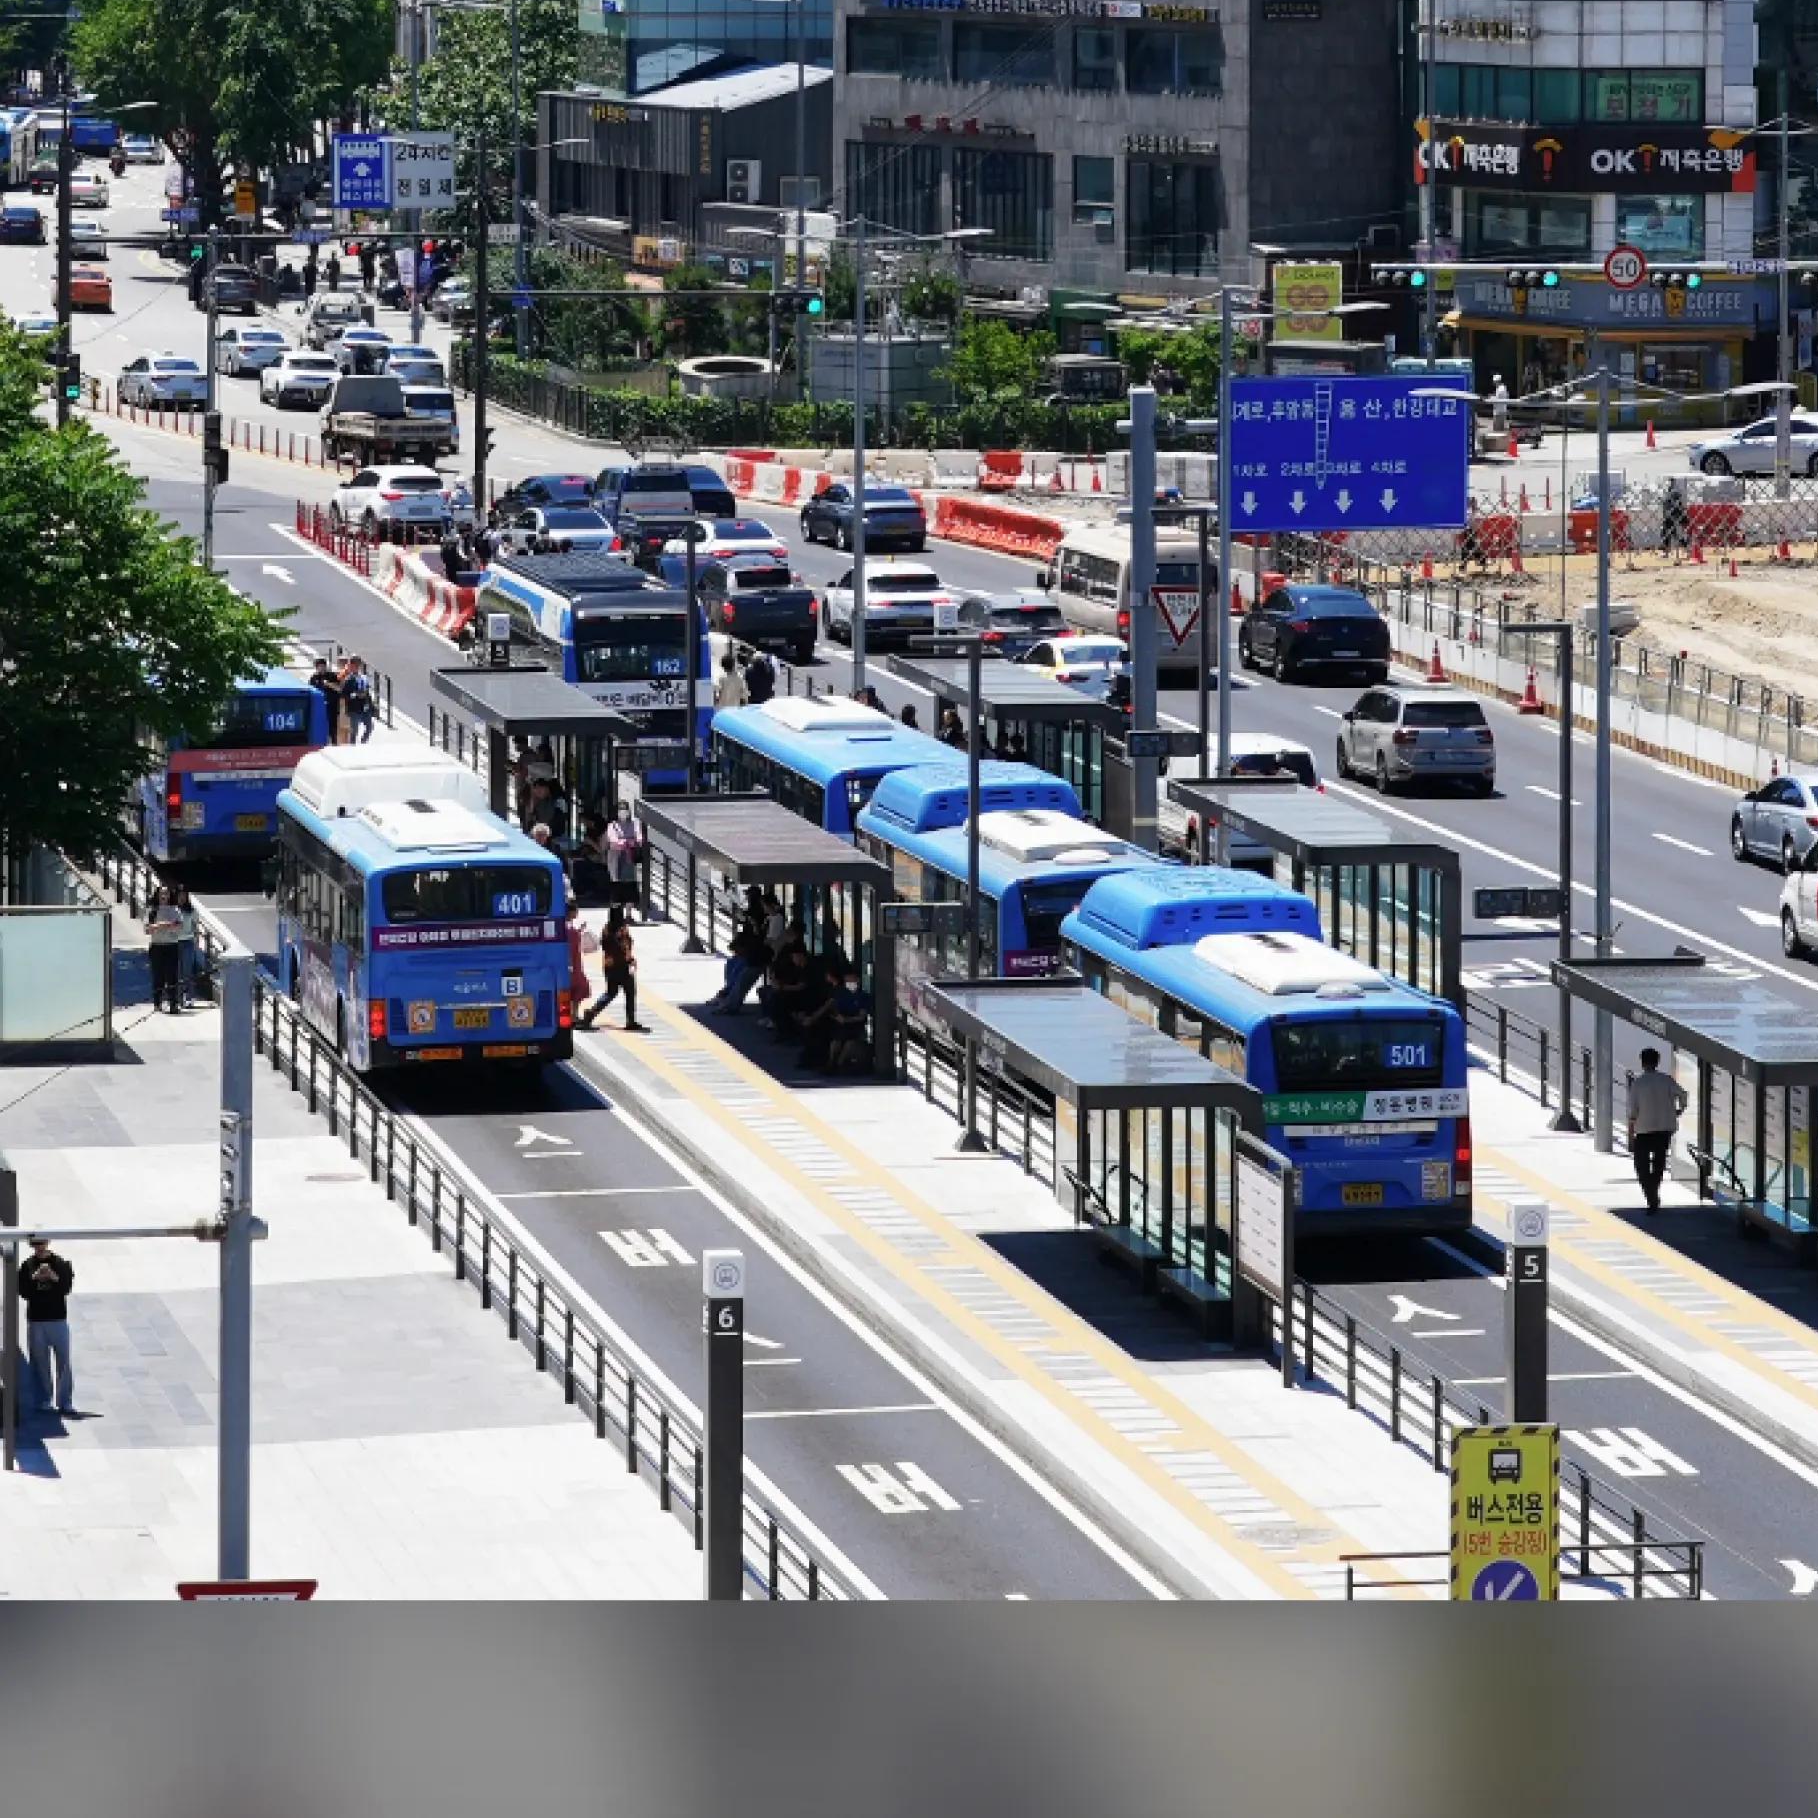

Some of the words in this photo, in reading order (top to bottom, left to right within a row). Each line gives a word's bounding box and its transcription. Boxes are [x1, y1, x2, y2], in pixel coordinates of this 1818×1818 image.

[1590, 148, 1635, 173] OK
[1659, 148, 1744, 173] 저축은행
[1610, 257, 1638, 278] 50
[1608, 291, 1661, 313] MEGA
[1686, 291, 1742, 310] COFFEE
[267, 713, 296, 731] 104
[497, 892, 533, 915] 401
[1390, 1045, 1426, 1066] 501
[597, 1228, 698, 1267] 버
[1524, 1254, 1539, 1278] 5
[717, 1305, 736, 1329] 6
[1558, 1427, 1701, 1478] 버
[834, 1461, 964, 1515] 버
[1466, 1491, 1544, 1526] 버스전용
[1498, 1529, 1547, 1556] 승강장)
